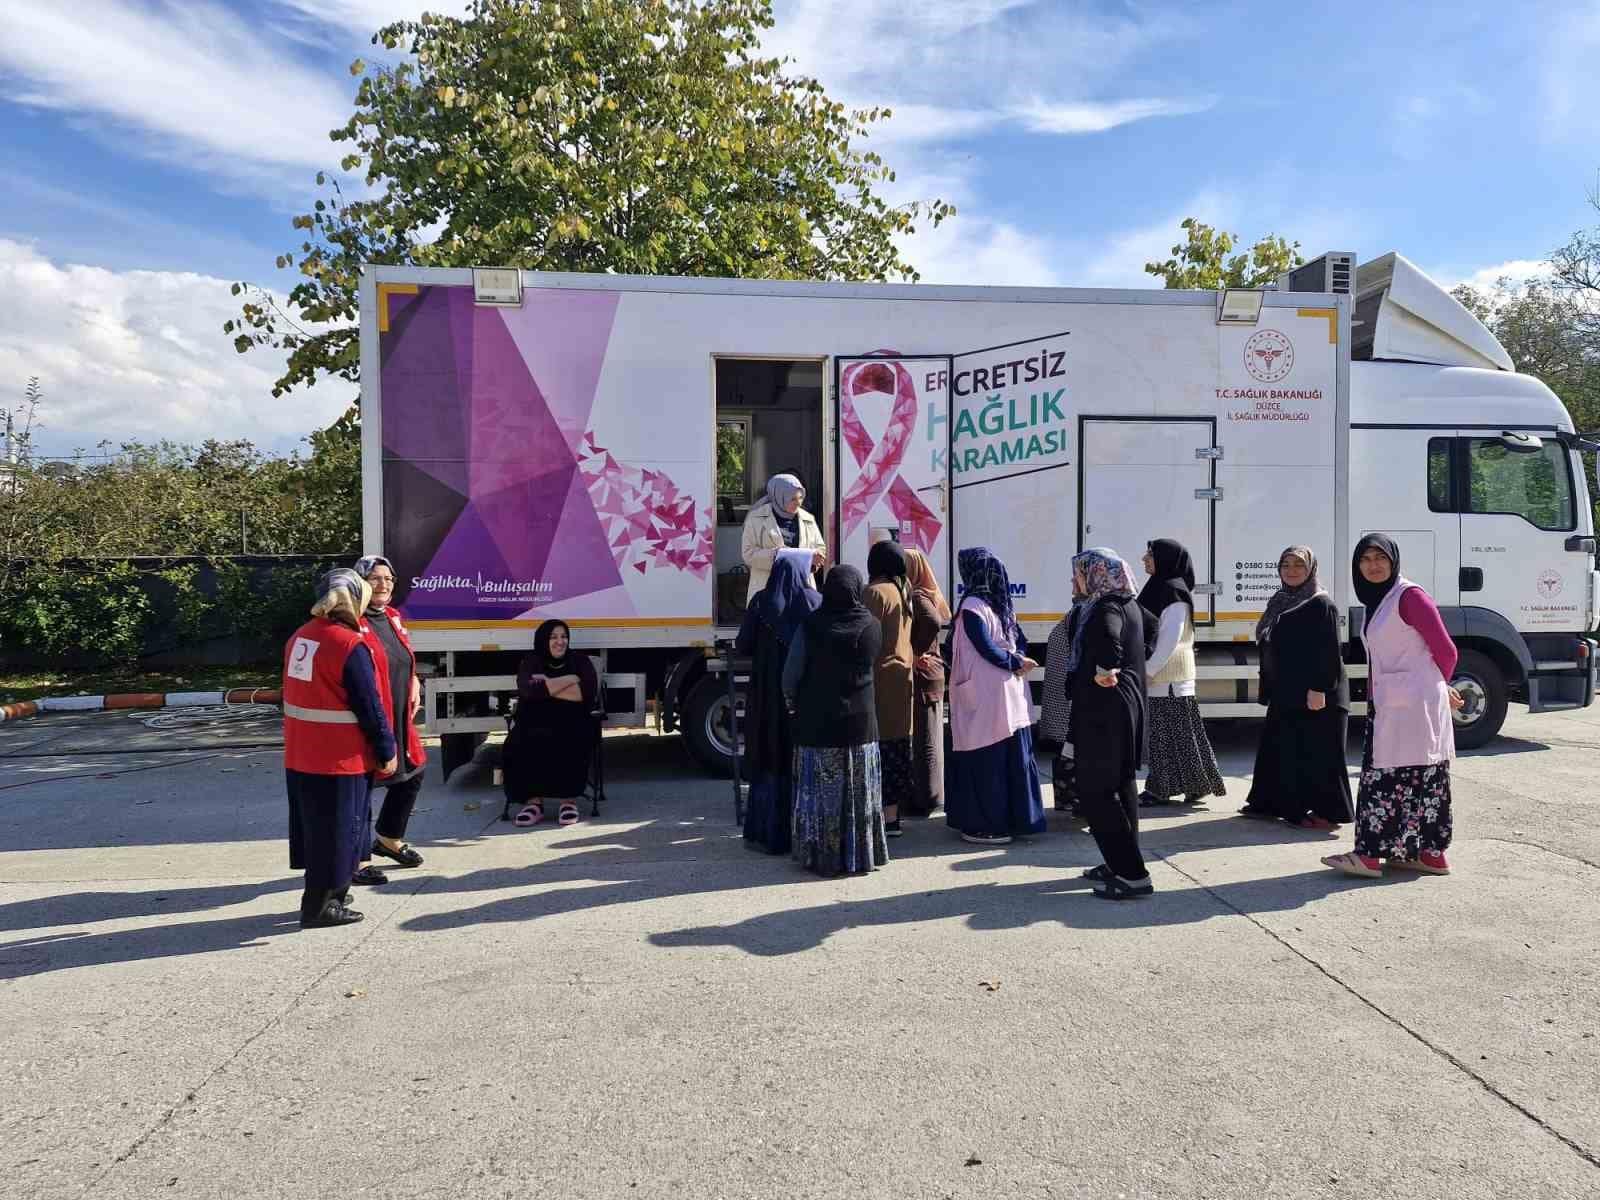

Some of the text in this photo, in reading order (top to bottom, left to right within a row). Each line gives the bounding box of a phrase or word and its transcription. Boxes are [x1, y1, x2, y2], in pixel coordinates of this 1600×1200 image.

[1215, 388, 1322, 400] T.C. SAĞLIK BAKANLIĞI
[410, 575, 472, 592] Sağlıkta
[484, 578, 554, 596] Buluşalım
